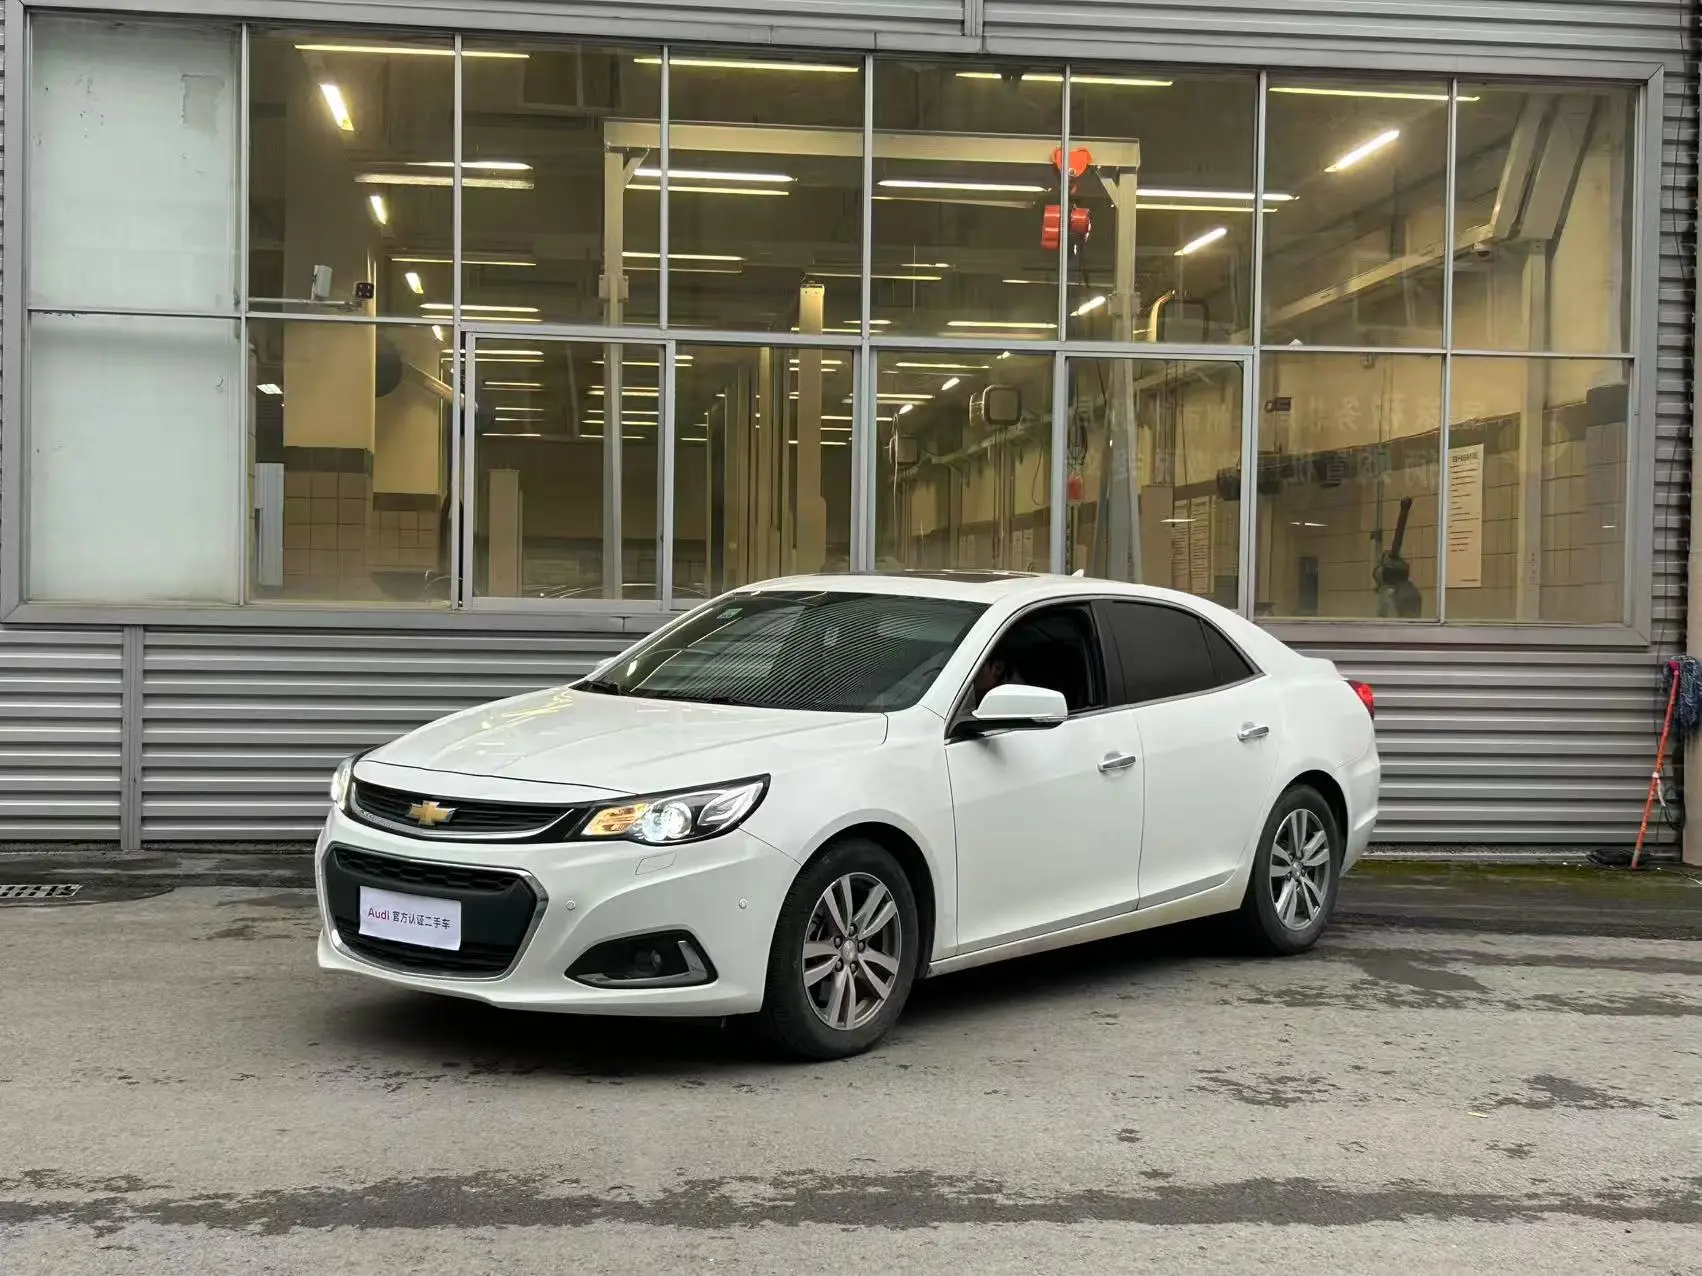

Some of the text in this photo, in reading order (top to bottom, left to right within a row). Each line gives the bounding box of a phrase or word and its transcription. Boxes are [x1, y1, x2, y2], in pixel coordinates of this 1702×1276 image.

[368, 908, 450, 930] Audi 官方认证二手车
